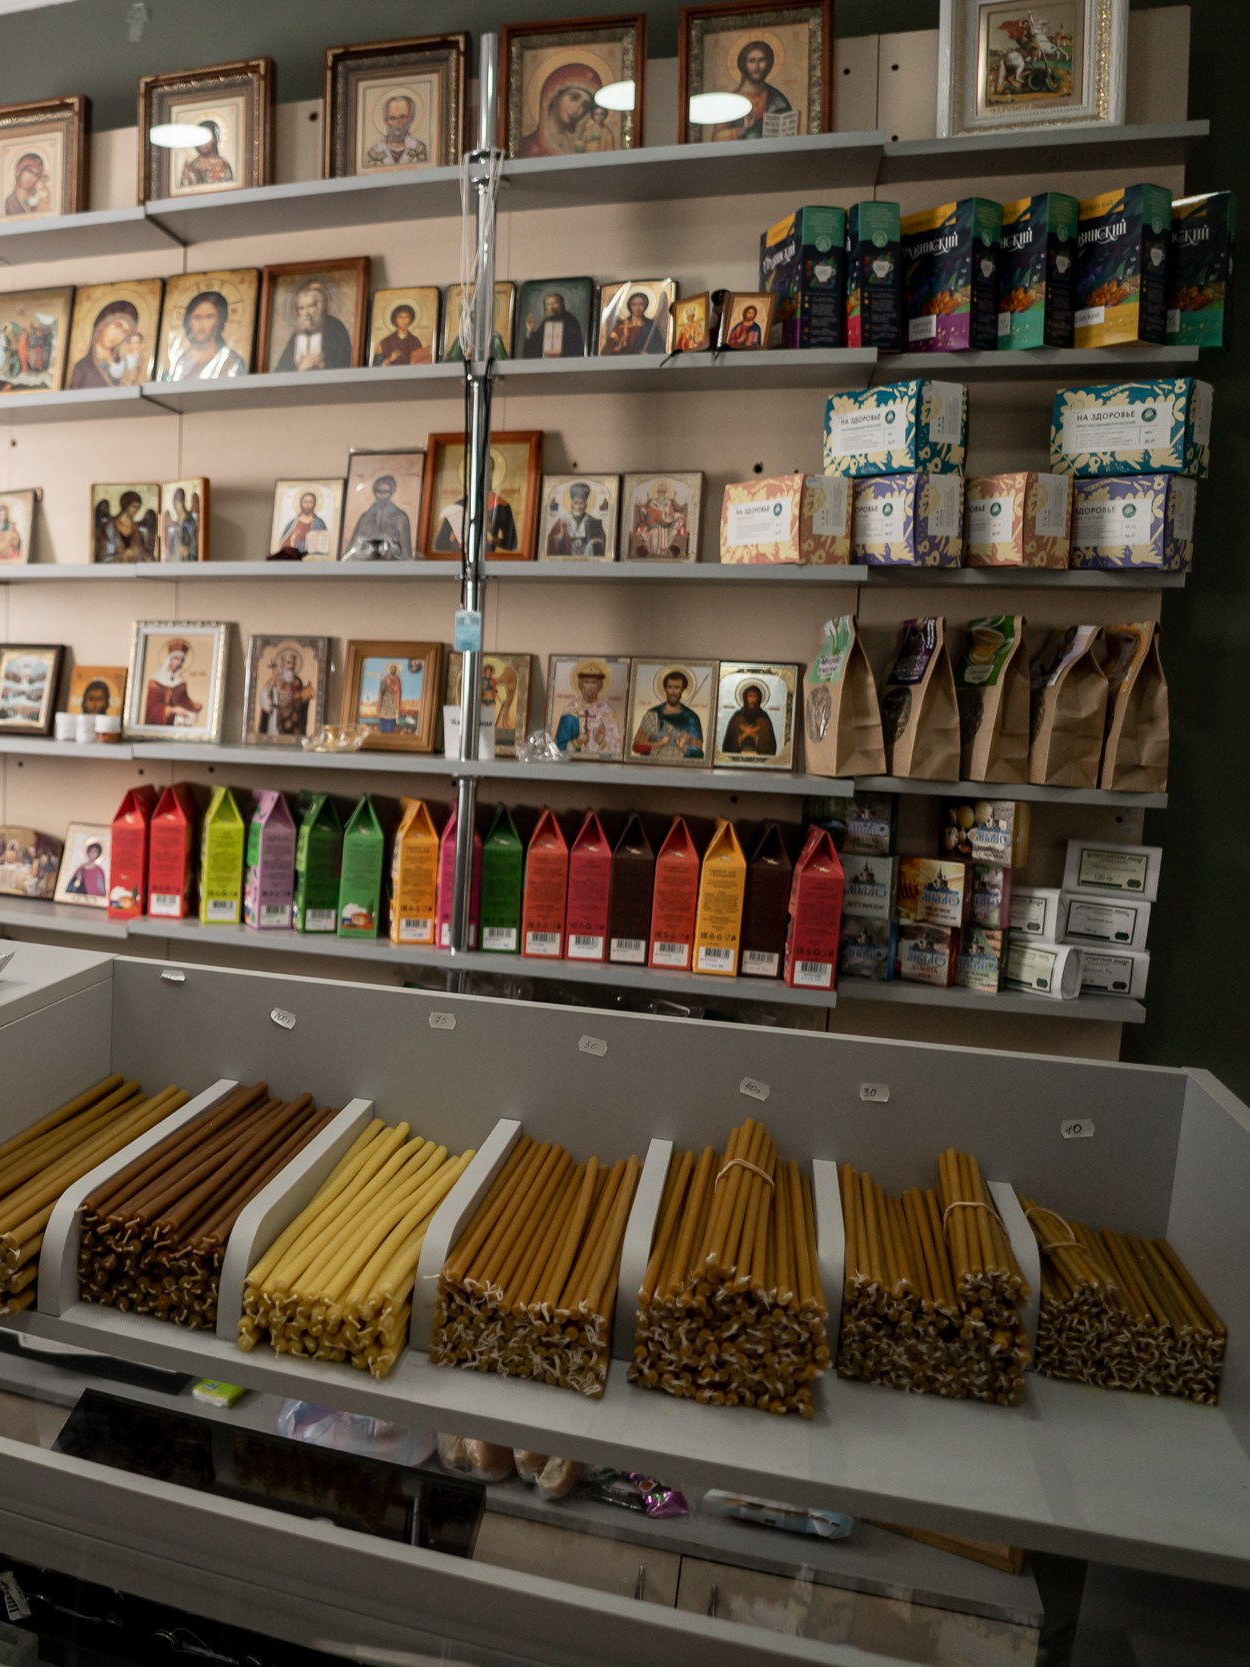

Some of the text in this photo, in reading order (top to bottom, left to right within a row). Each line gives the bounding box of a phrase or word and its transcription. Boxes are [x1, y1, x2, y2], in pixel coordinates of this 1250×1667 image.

[840, 414, 882, 425] НА ЗДОРОВЬЕ
[1076, 410, 1136, 422] НА ЗДОРОВЬЕ
[583, 1040, 599, 1050] 50
[863, 1087, 877, 1097] 30
[1065, 1123, 1082, 1134] 10
